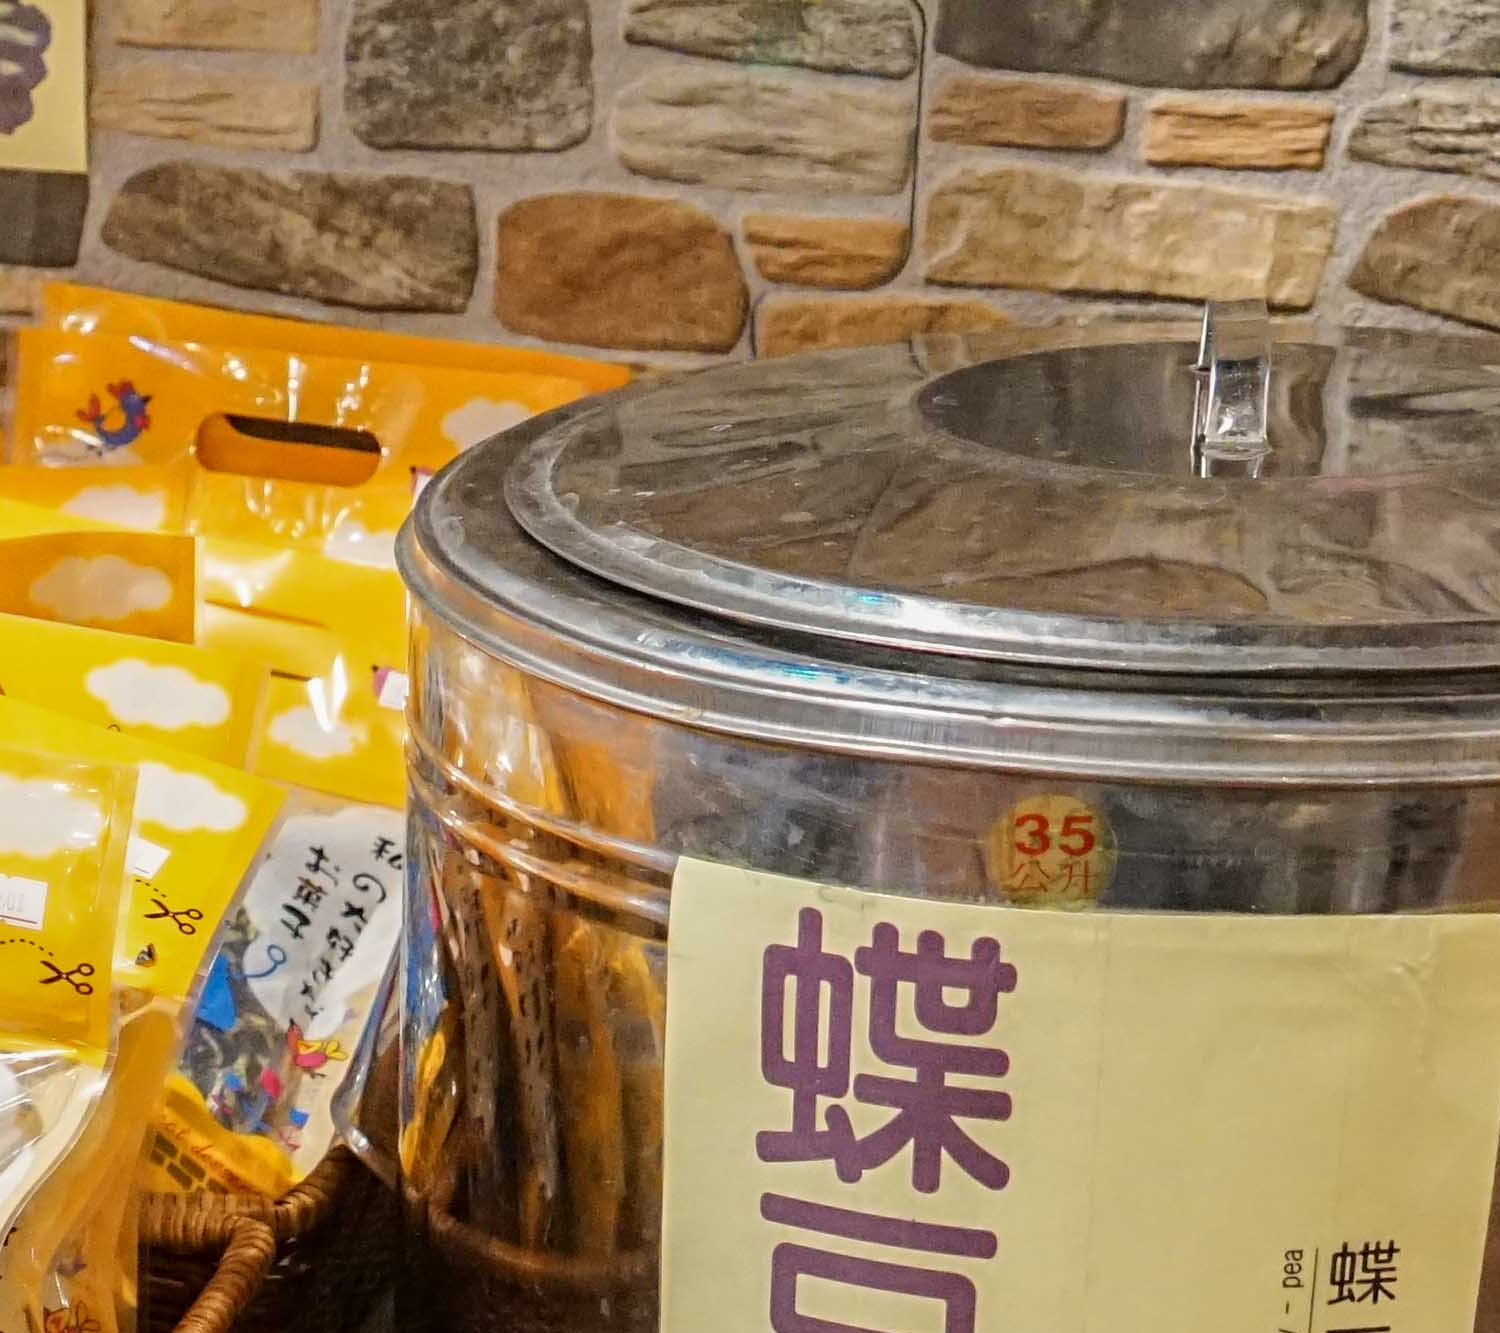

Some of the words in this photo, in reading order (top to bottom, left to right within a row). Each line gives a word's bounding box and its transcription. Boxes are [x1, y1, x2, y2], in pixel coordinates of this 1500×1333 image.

[1014, 813, 1095, 857] 35
[1010, 860, 1098, 894] 公升
[1282, 1248, 1305, 1289] pea
